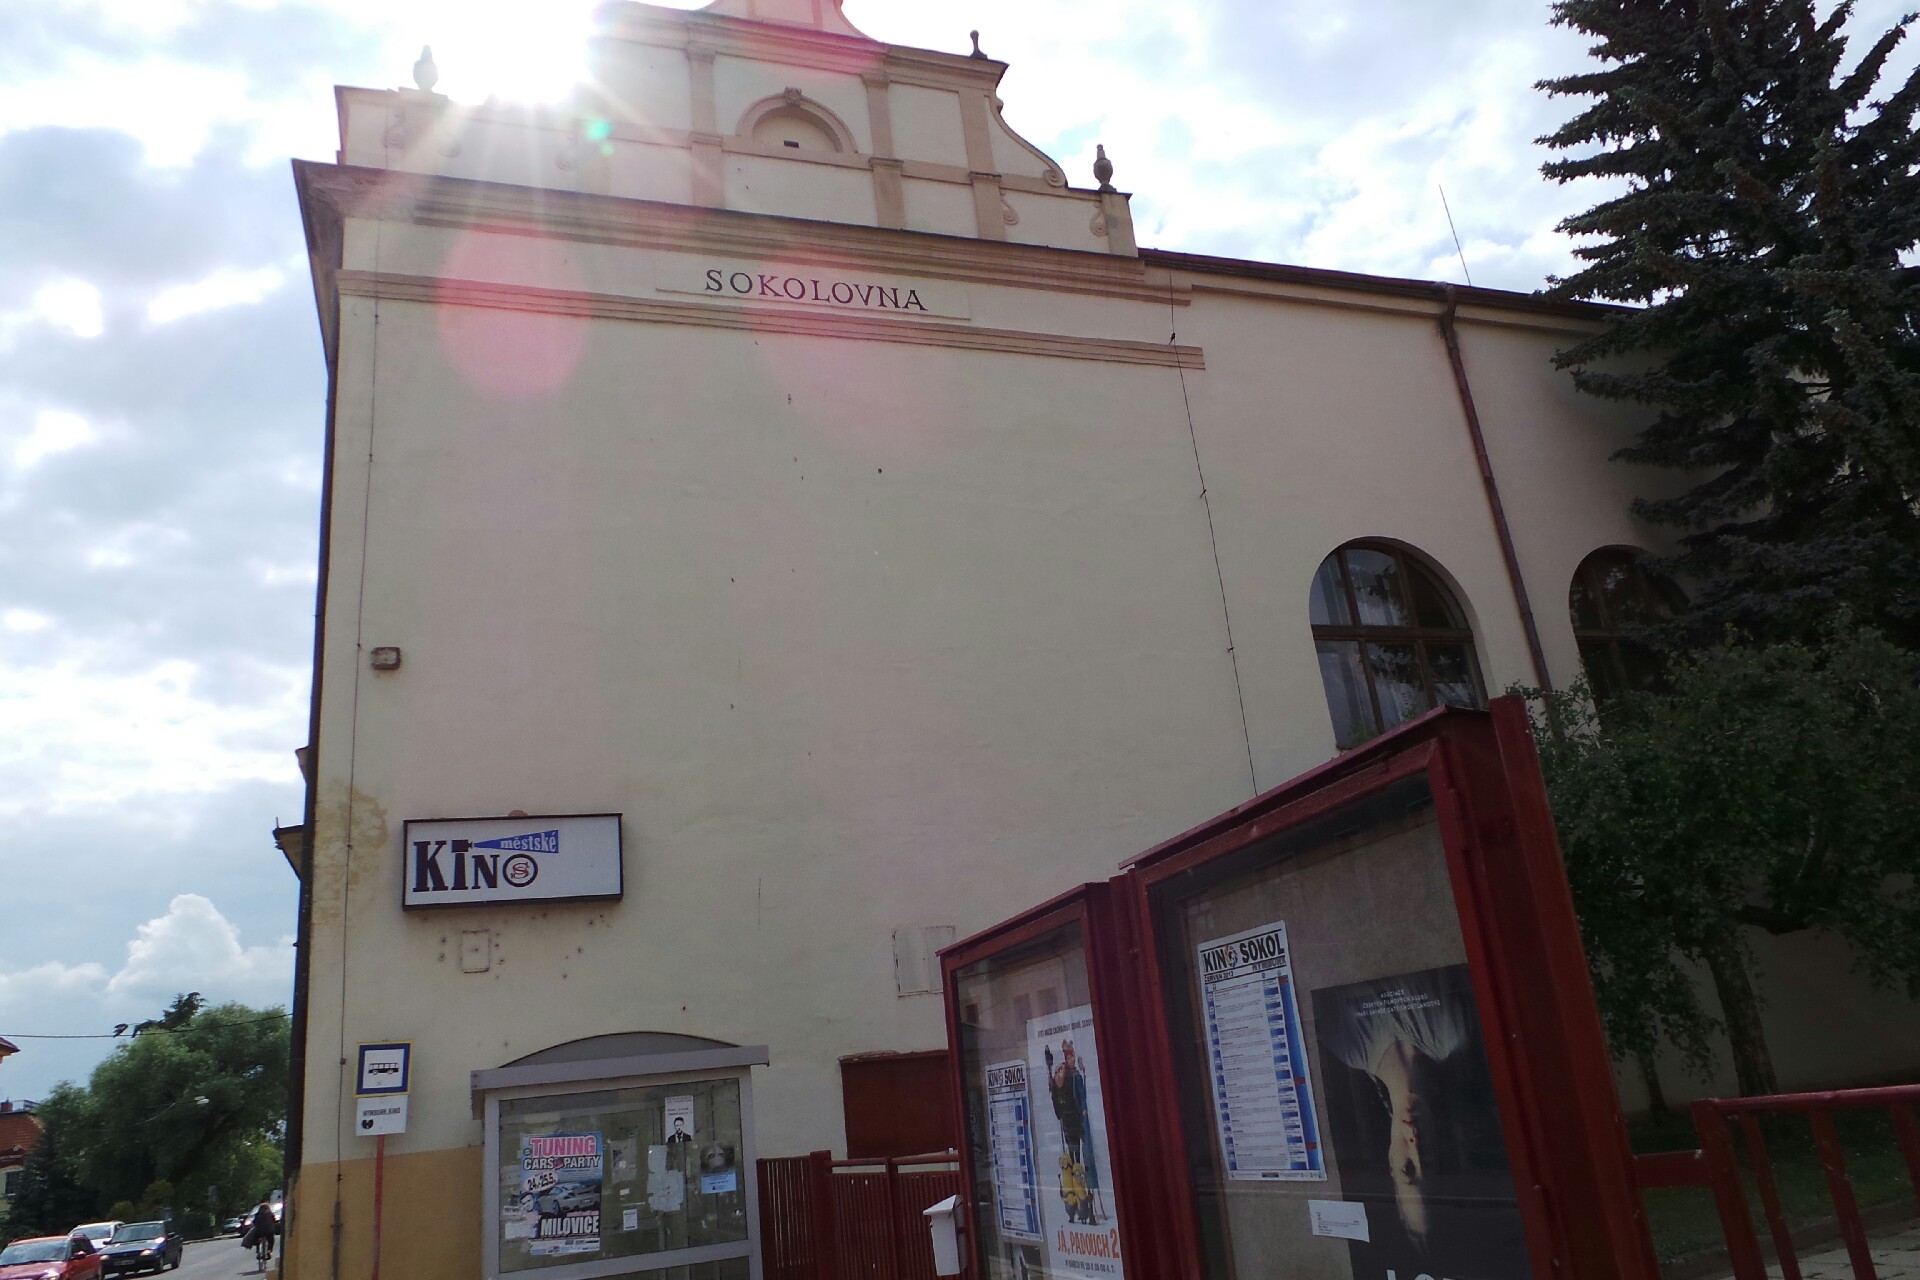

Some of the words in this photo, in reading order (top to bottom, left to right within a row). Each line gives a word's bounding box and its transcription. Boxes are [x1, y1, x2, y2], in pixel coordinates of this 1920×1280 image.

[705, 268, 928, 312] SOKOLOVNA
[500, 832, 556, 852] městské
[1239, 933, 1285, 963] SOKOL
[1004, 1067, 1026, 1084] SOKOL
[529, 1136, 597, 1157] TUNING
[524, 1158, 554, 1170] CARS
[563, 1155, 601, 1169] PARTY
[541, 1216, 600, 1237] MILOVICE
[1069, 1231, 1110, 1258] PADOUCH
[1109, 1227, 1120, 1259] 2
